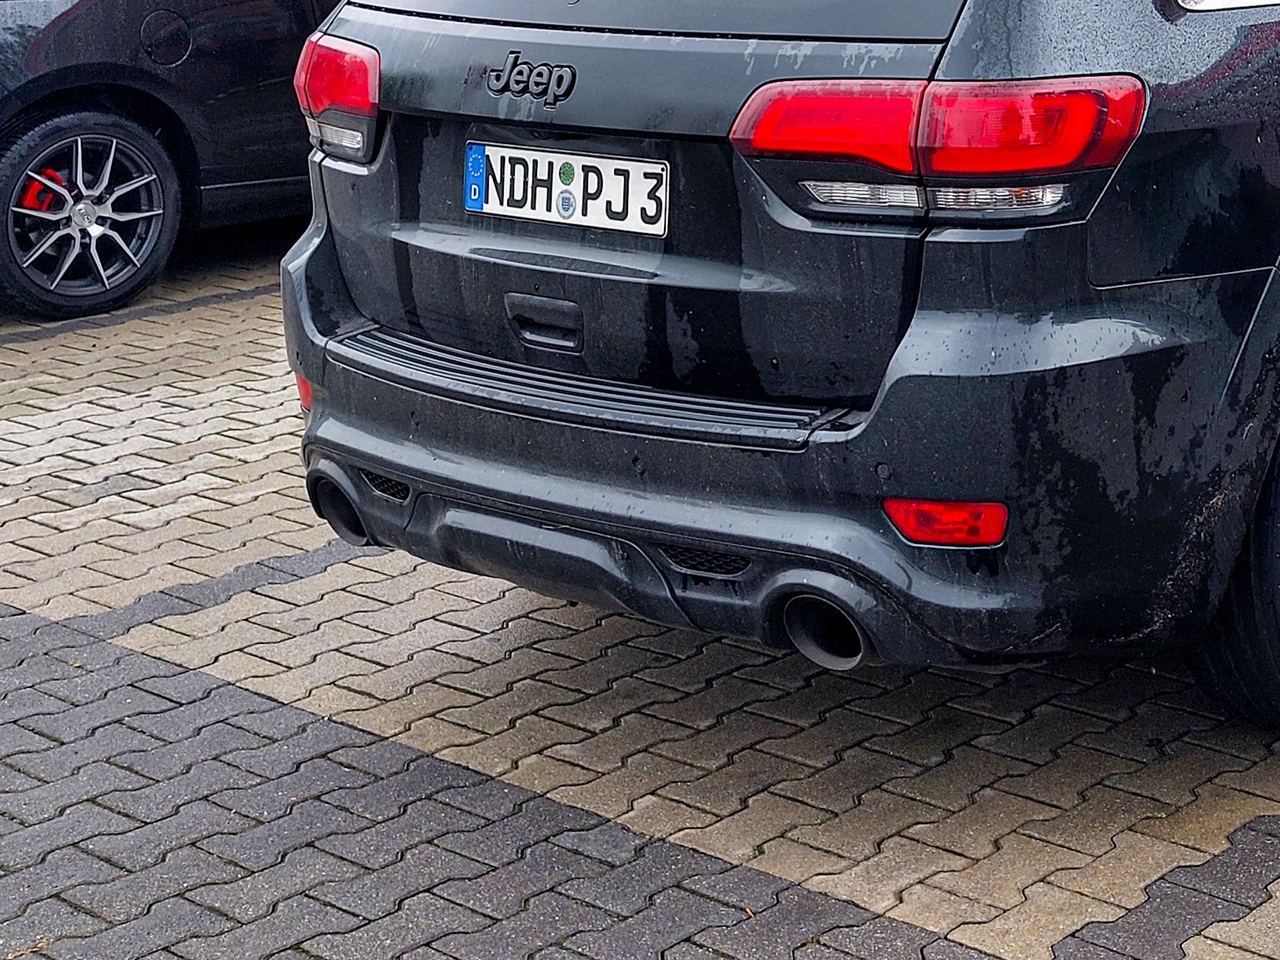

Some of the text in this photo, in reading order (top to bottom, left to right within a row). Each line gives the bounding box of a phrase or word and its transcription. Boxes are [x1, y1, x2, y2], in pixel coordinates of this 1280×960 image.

[487, 50, 577, 110] Jeep
[470, 184, 479, 200] D
[484, 154, 554, 212] NDH
